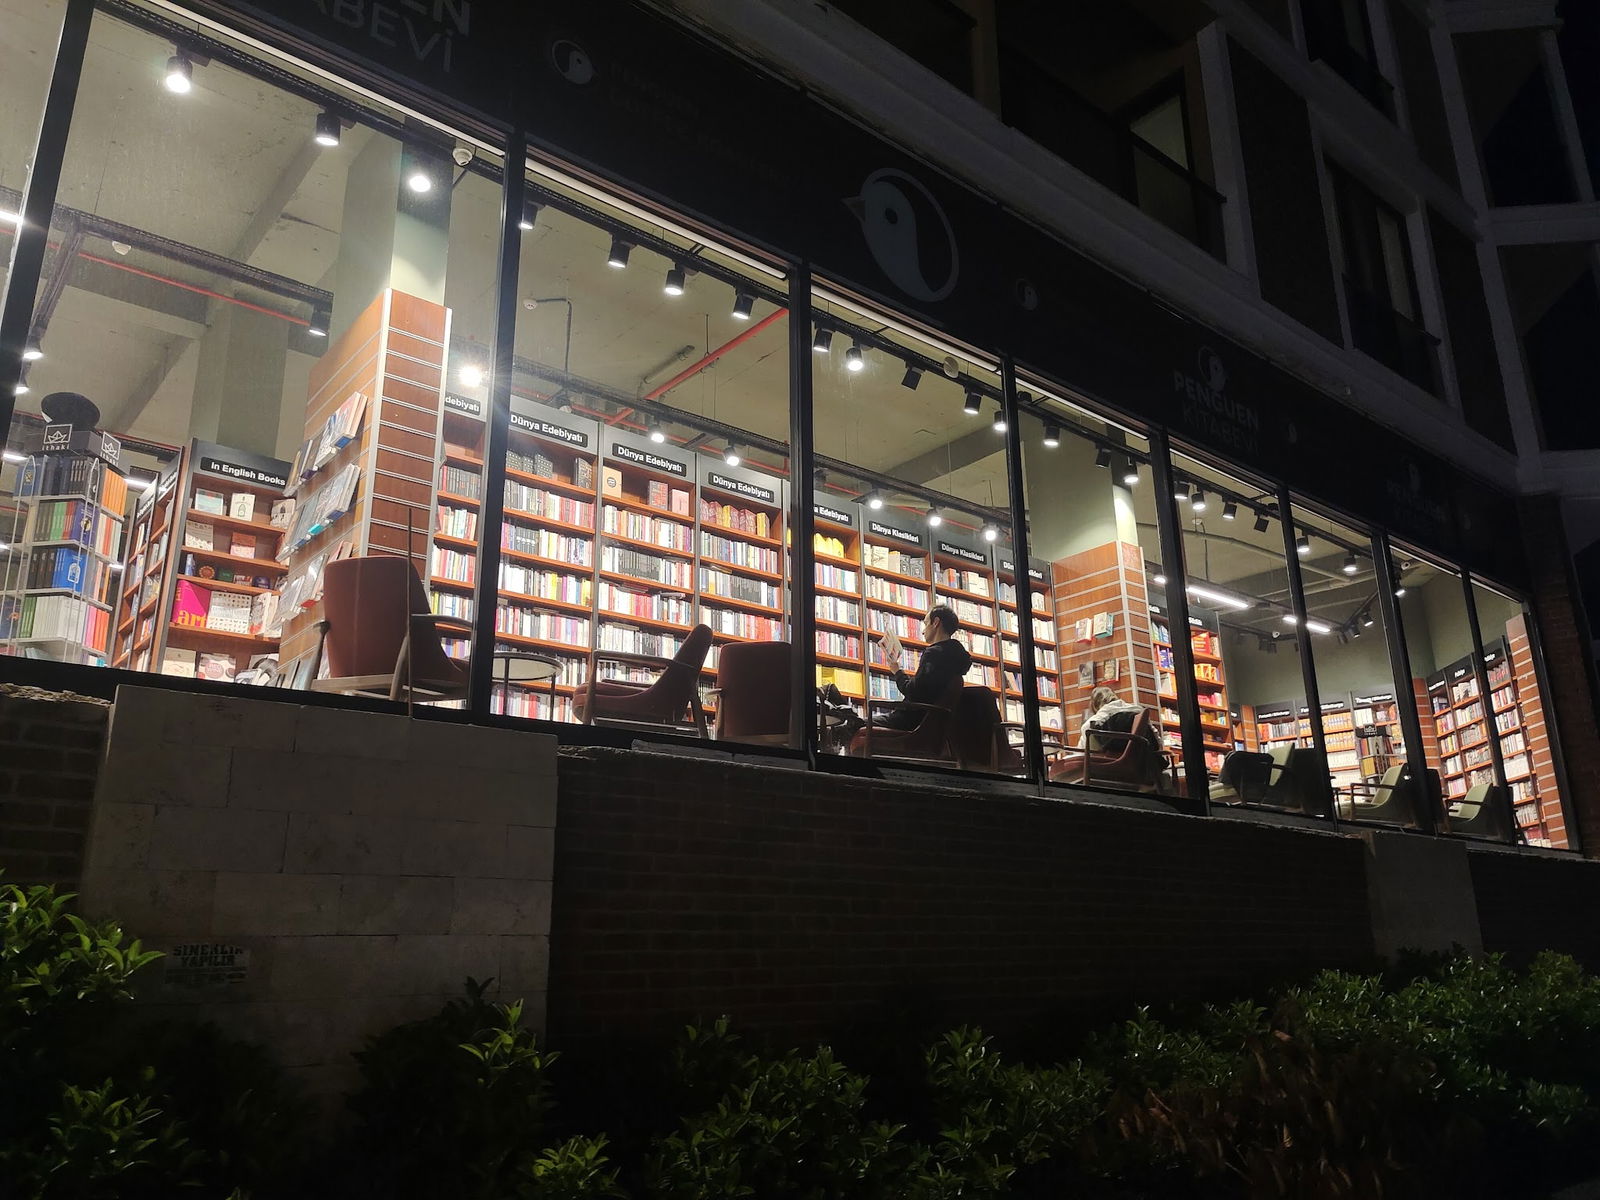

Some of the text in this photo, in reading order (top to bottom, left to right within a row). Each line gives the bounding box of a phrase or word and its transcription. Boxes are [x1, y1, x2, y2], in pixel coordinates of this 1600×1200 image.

[445, 396, 480, 412] debiyatı
[1172, 369, 1260, 431] PENGUEN
[510, 414, 583, 443] Dünya Edebiyatı
[42, 443, 70, 451] ithaki
[618, 447, 682, 473] Dünya Edebiyatı
[211, 461, 286, 486] In English Books
[712, 475, 770, 499] Dünya Edebiyatı
[872, 523, 919, 543] Dünya Klasikleri
[941, 543, 984, 563] Dünya Klasikleri
